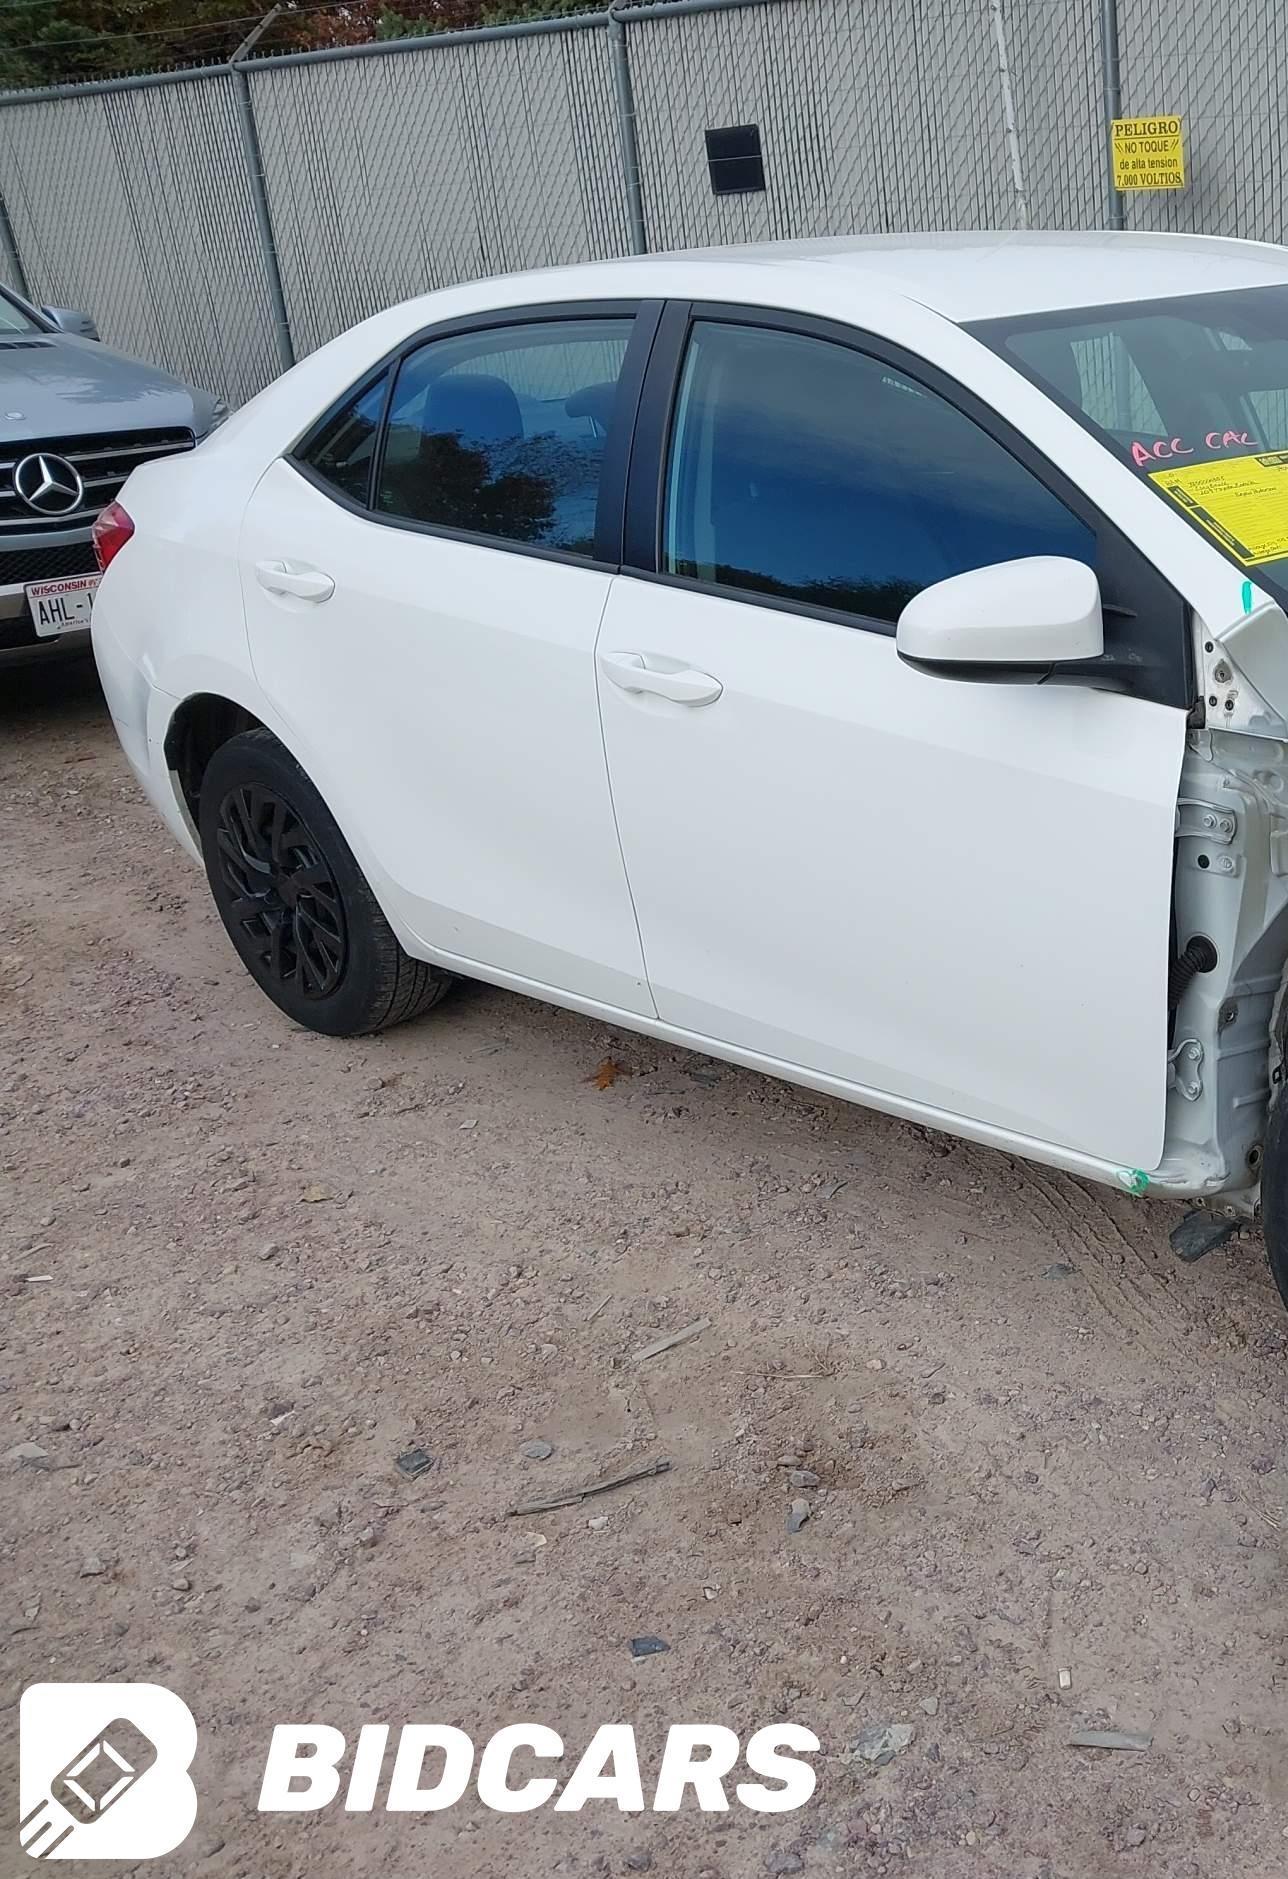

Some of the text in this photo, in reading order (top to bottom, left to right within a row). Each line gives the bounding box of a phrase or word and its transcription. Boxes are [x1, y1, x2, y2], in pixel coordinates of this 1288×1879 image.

[1115, 120, 1178, 137] PELIGRO
[1124, 140, 1169, 154] NO TOQUE
[1119, 159, 1130, 170] de
[1147, 156, 1178, 169] tension
[1116, 171, 1181, 187] 7.000 VOLTIOS
[1131, 438, 1194, 467] ACC
[31, 580, 87, 597] WISCONSIN
